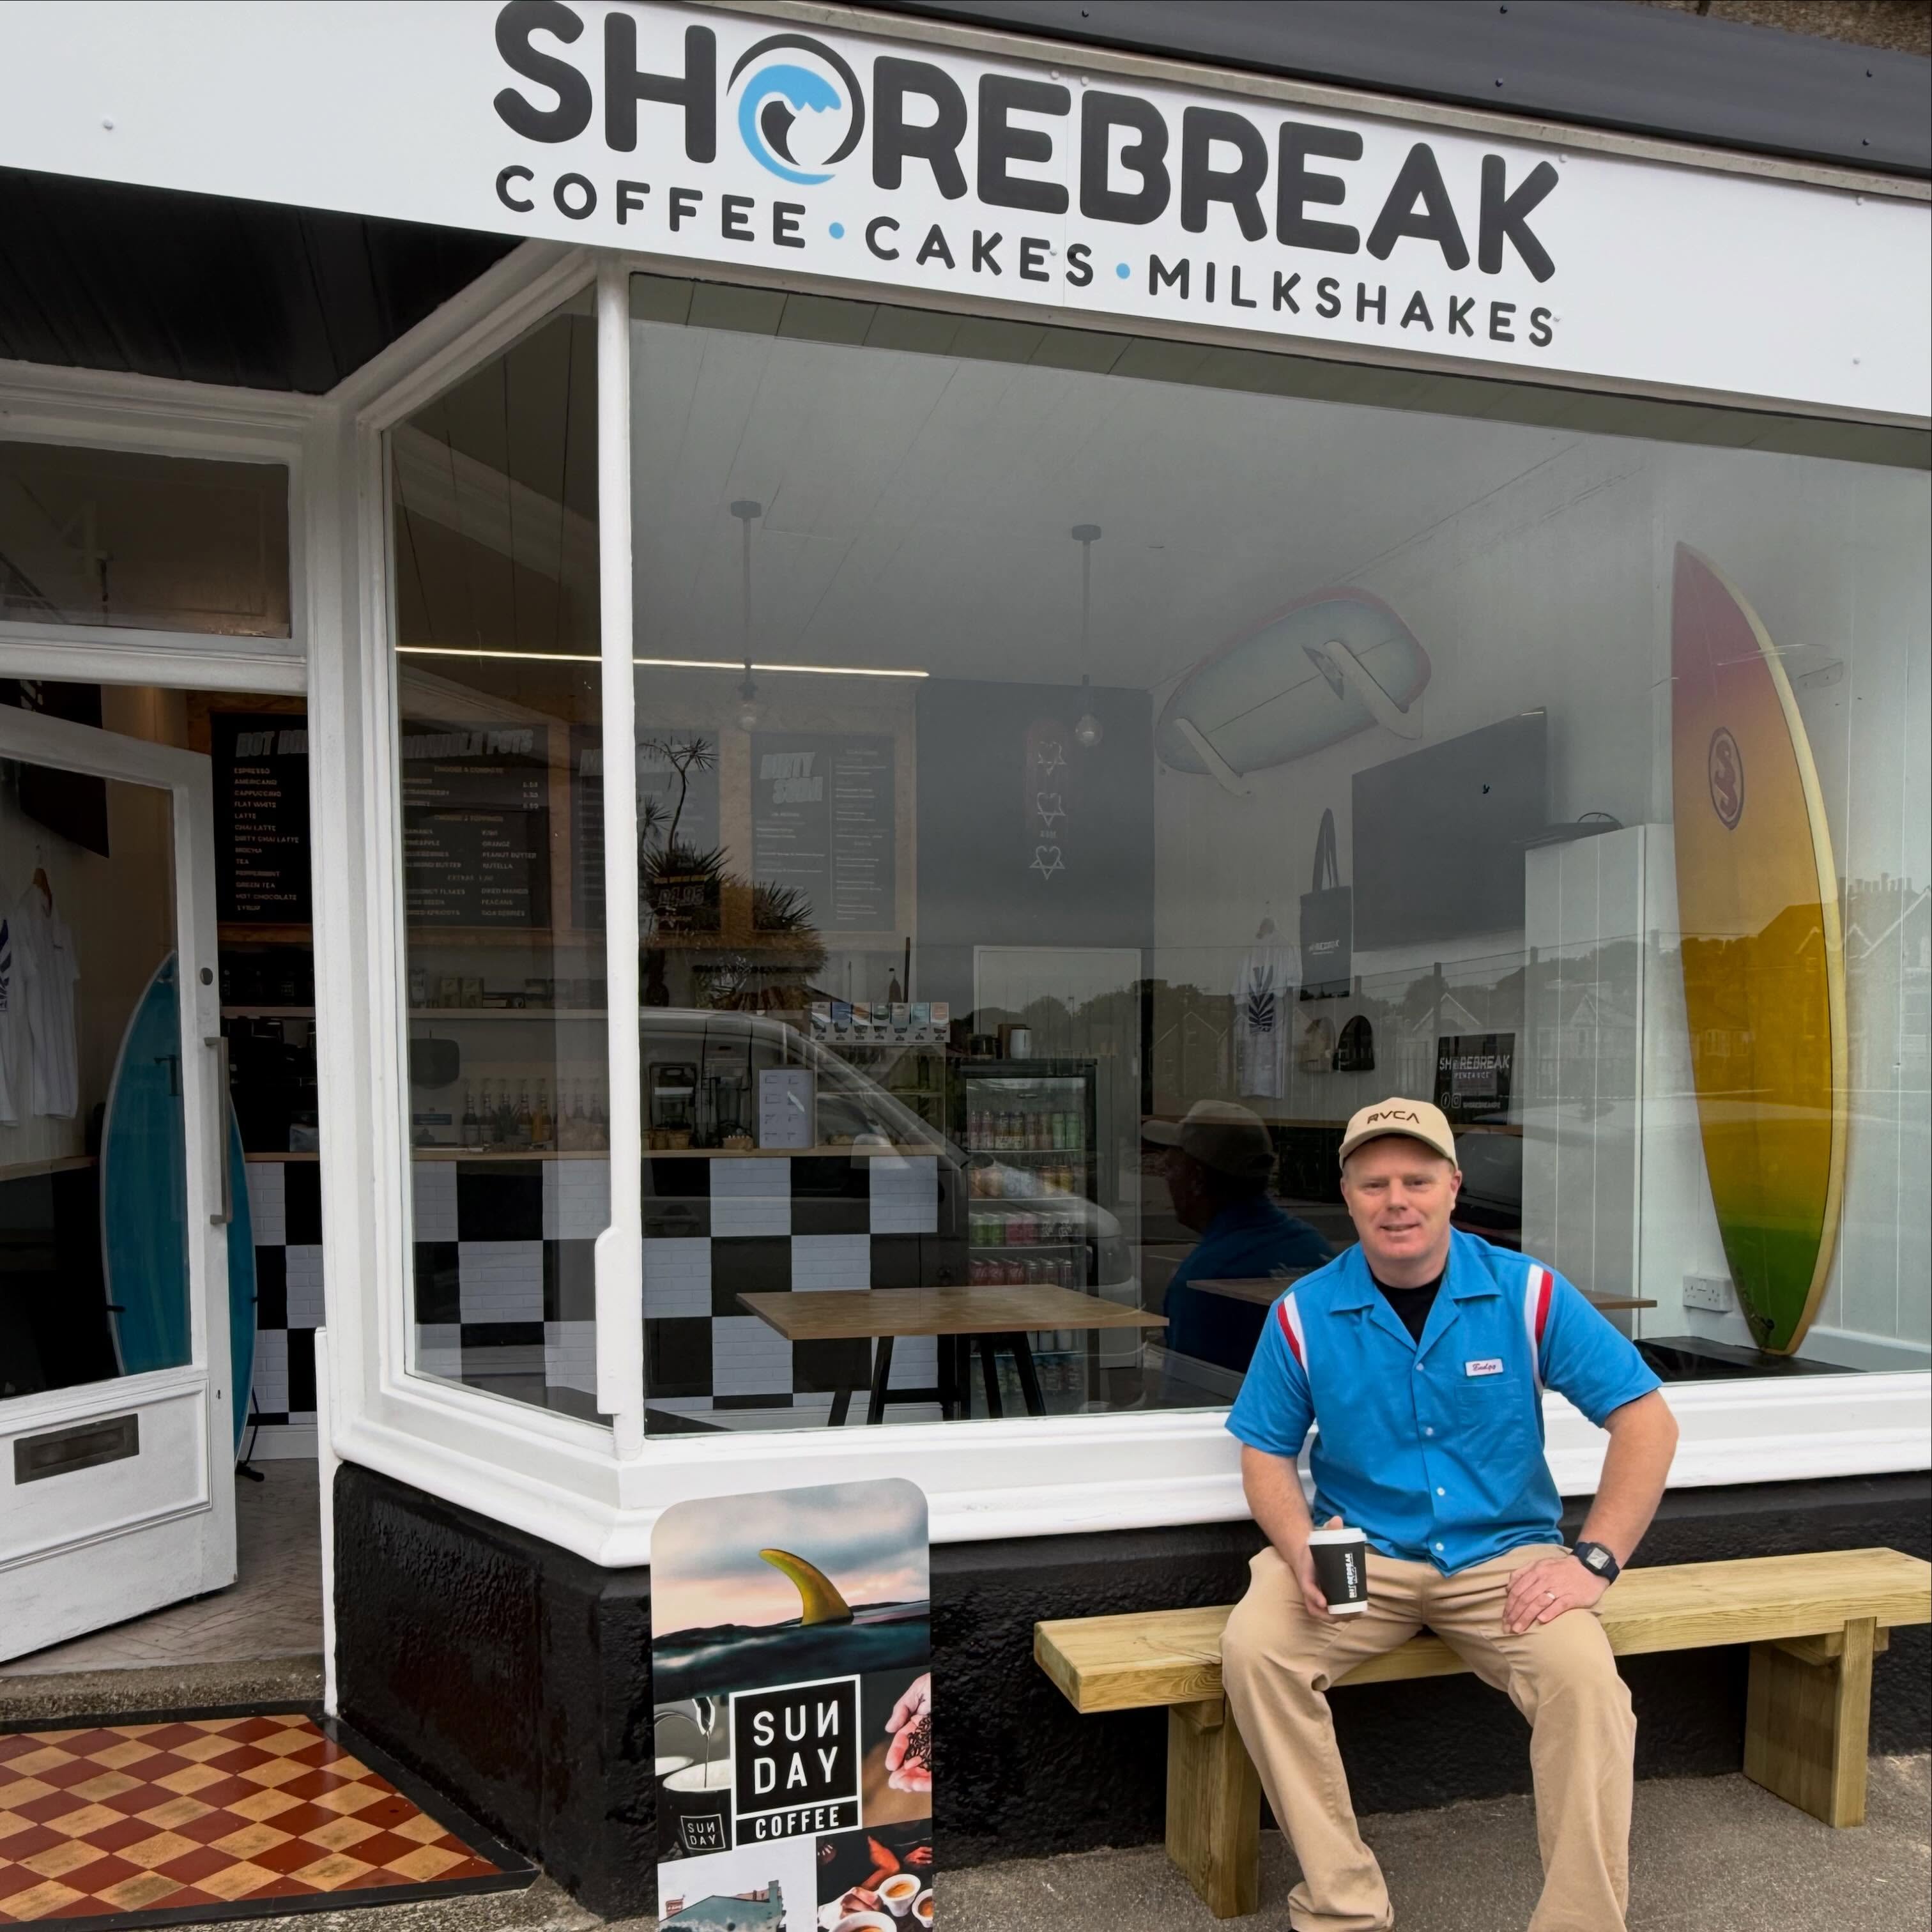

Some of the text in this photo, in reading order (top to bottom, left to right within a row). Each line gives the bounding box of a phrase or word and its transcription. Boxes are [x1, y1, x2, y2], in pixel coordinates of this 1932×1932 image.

[494, 0, 1559, 283] SHOREBREAK
[496, 165, 1554, 348] COFFEE CAKES MILKSHAKES
[1367, 1110, 1420, 1124] RVCA
[754, 1746, 839, 1795] DAY
[689, 1834, 716, 1846] DAY
[755, 1805, 839, 1840] COFFEE
